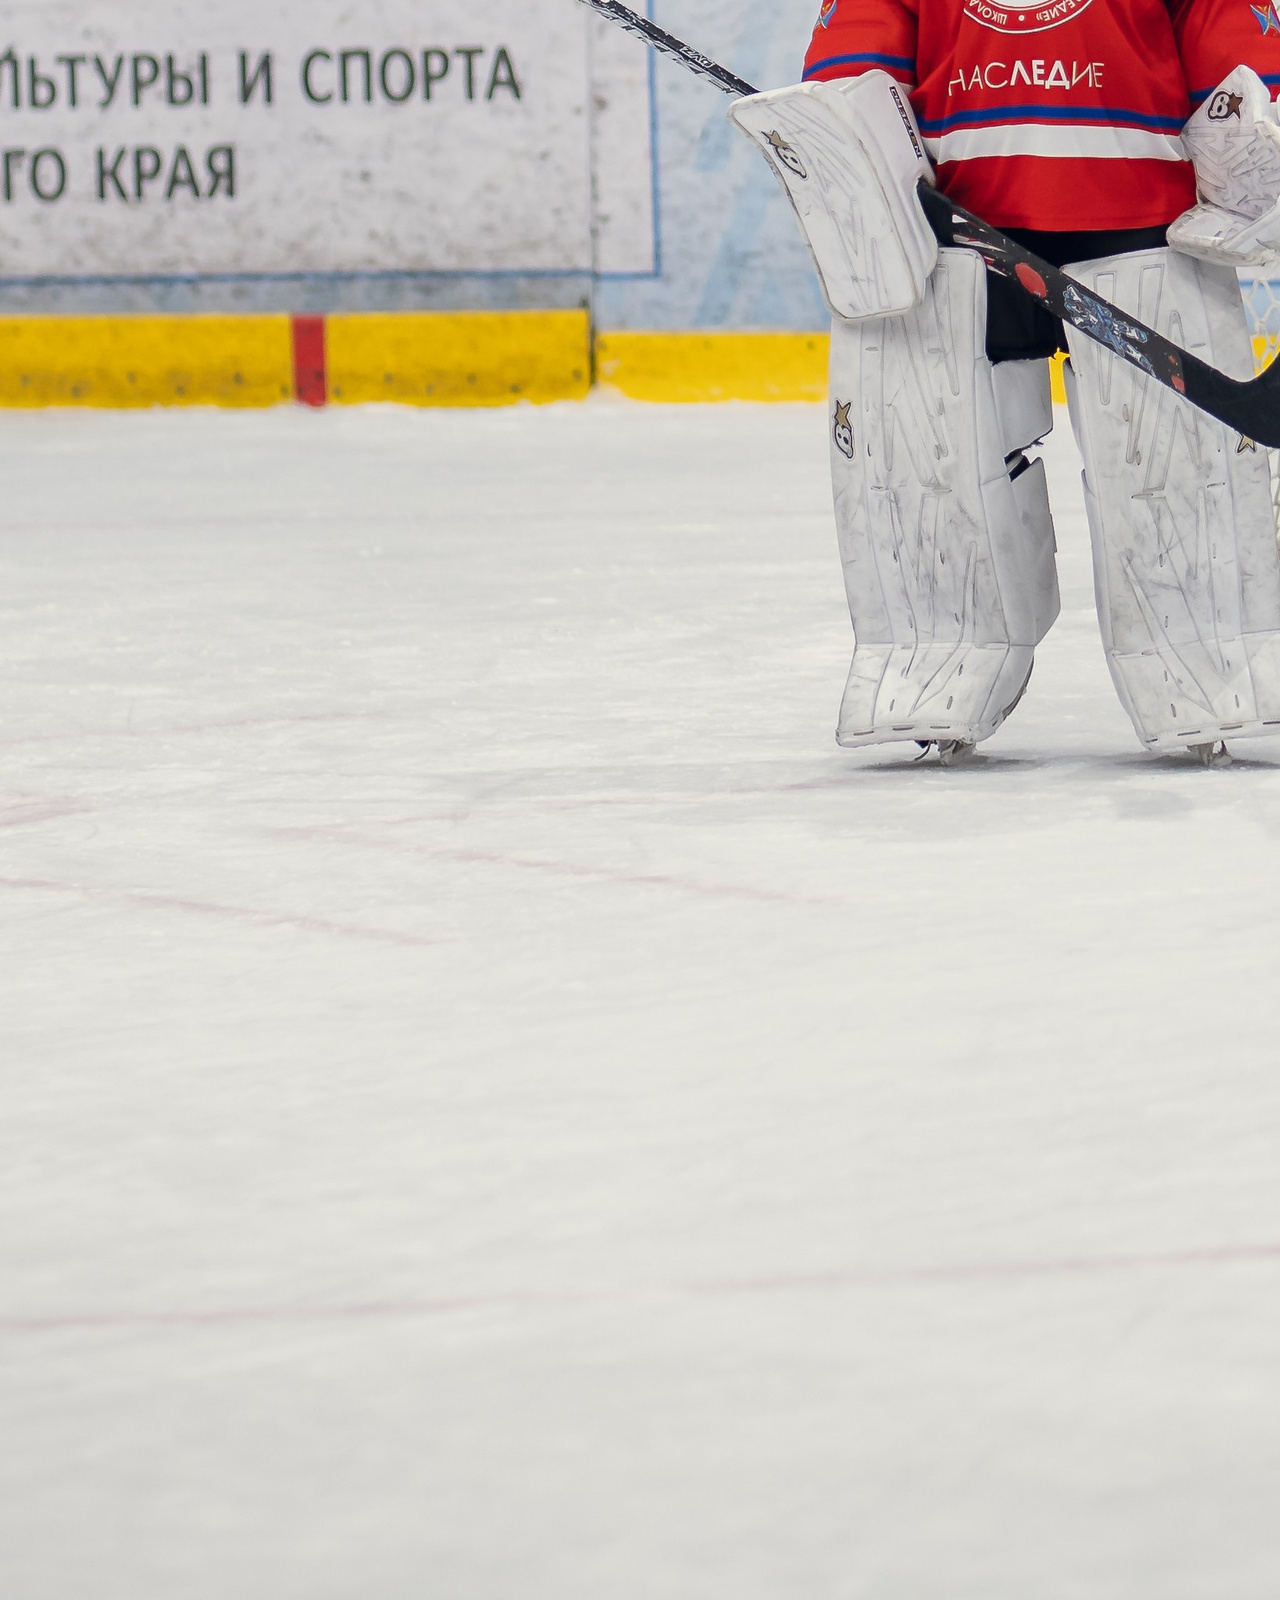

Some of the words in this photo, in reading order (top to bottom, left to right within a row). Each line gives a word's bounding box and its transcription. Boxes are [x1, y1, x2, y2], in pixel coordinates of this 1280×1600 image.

[238, 49, 274, 104] И
[302, 46, 523, 103] СПОРТА
[947, 59, 1105, 97] НАСЛЕДИЕ
[3, 147, 67, 202] ГО
[97, 144, 237, 201] КРАЯ
